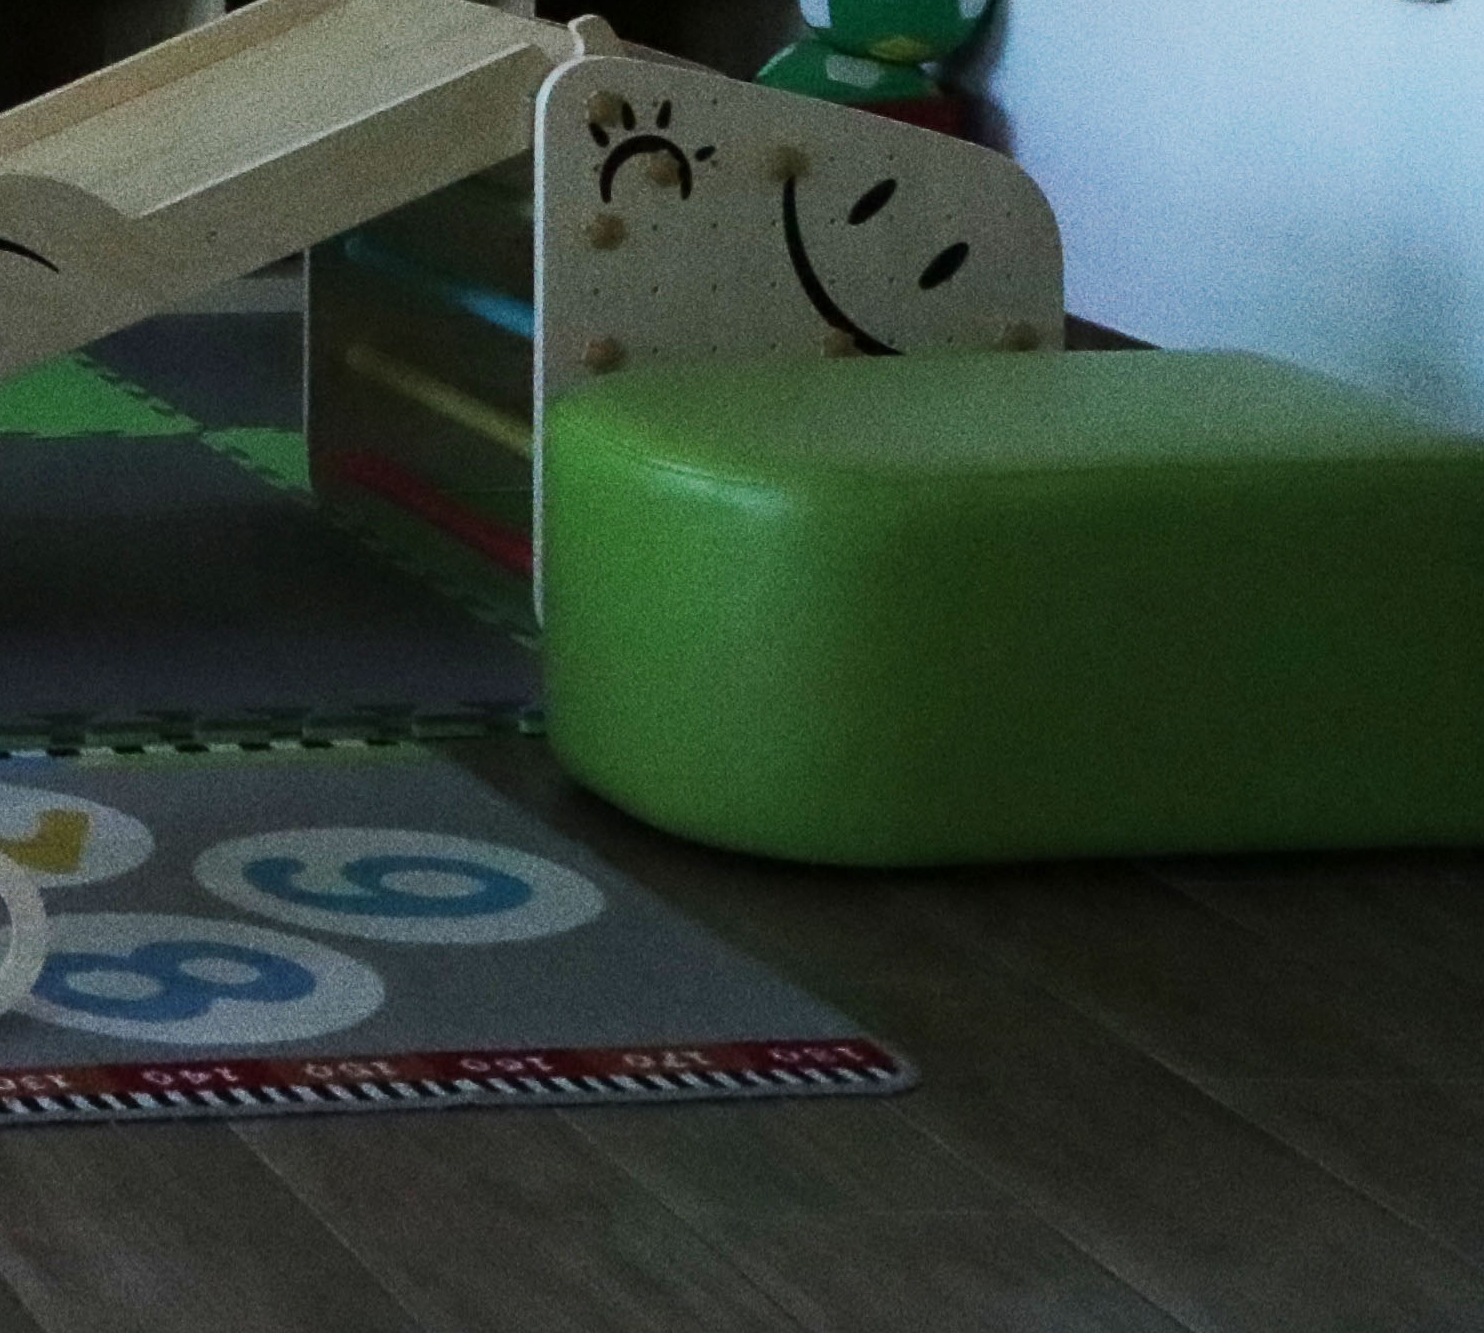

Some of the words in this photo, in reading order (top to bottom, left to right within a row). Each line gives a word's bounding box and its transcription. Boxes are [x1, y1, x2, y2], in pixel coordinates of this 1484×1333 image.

[244, 855, 533, 919] 9
[33, 940, 316, 1024] 8
[143, 1066, 239, 1086] 140
[622, 1050, 711, 1070] 170
